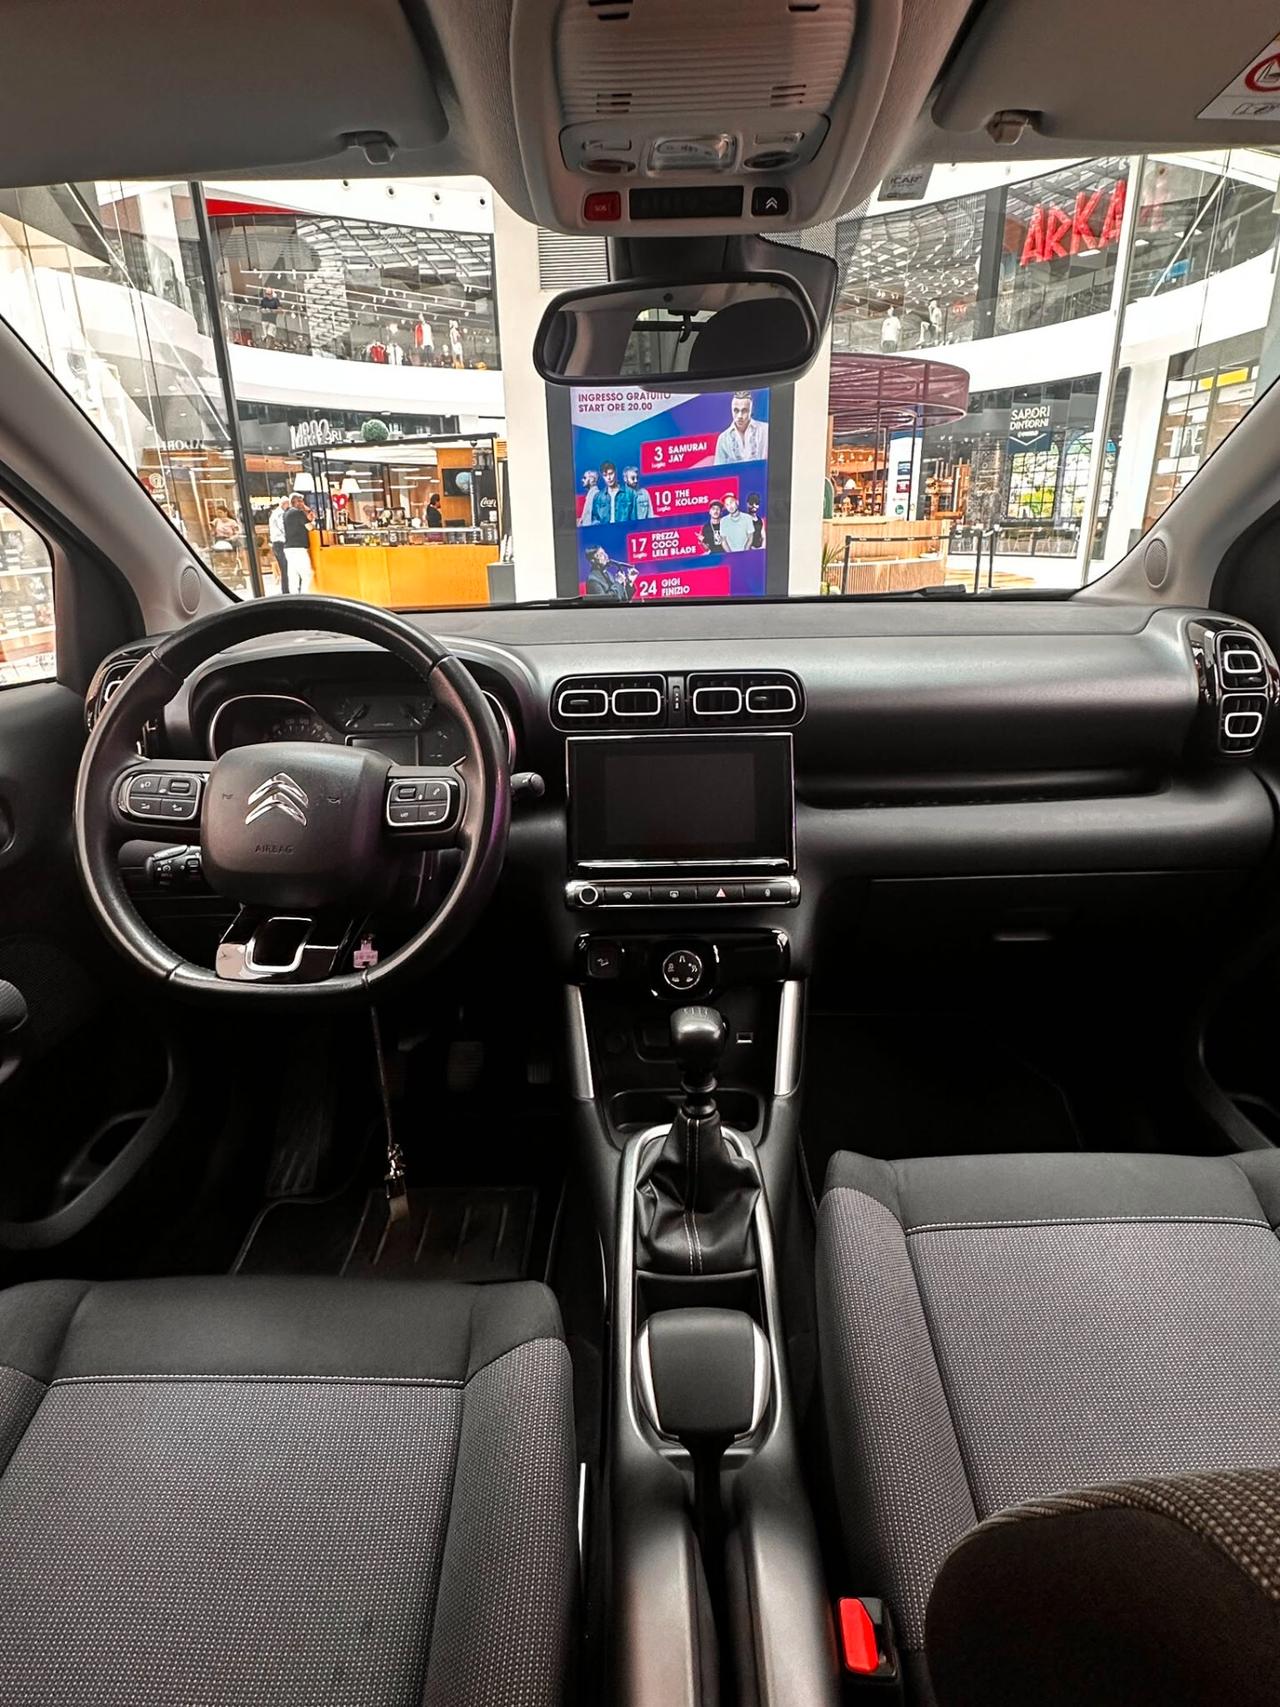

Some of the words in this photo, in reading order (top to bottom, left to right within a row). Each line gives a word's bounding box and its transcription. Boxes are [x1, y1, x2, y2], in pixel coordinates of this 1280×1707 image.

[578, 392, 624, 402] INGRESSO
[626, 392, 671, 400] GRATUITO
[578, 403, 605, 412] START
[607, 403, 625, 411] ORE
[628, 402, 653, 411] 20.00
[1010, 406, 1050, 420] SAPORI
[1009, 418, 1049, 430] DINTORNI
[654, 446, 664, 461] 3
[668, 442, 707, 454] SAMURAI
[668, 453, 684, 463] JAY
[654, 490, 672, 506] 10
[674, 489, 690, 498] THE
[675, 495, 709, 507] KOLORS
[630, 537, 648, 553] 17
[651, 539, 679, 549] COCO
[652, 548, 669, 557] LELE
[670, 545, 697, 556] BLADE
[639, 580, 658, 597] 24
[661, 578, 681, 588] GIGI
[661, 585, 690, 597] FINIZIO
